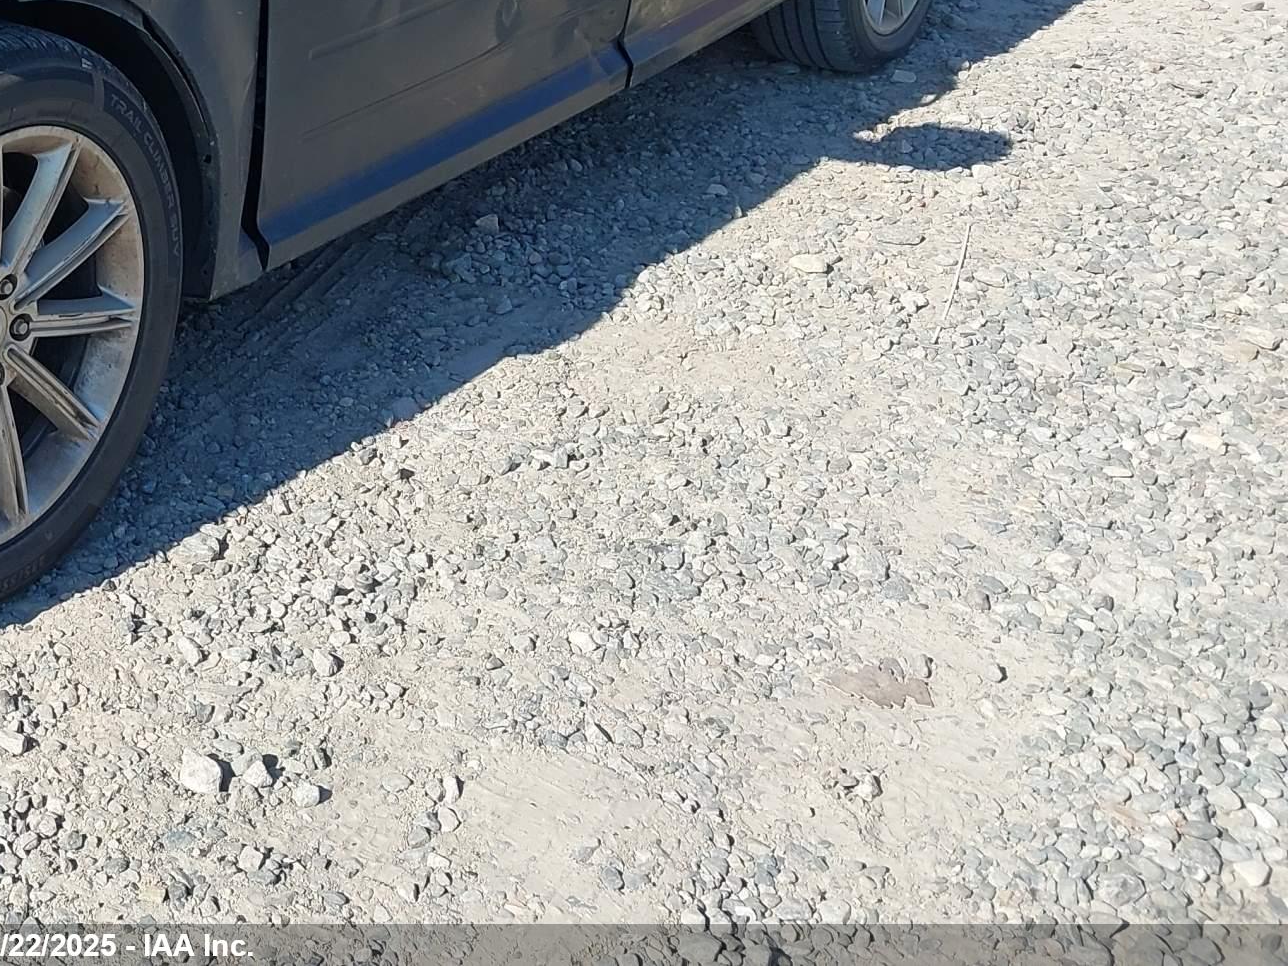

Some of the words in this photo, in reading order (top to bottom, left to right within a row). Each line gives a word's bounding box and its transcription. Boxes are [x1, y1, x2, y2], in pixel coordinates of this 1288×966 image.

[110, 93, 146, 133] TRAIL
[143, 131, 175, 209] CLIMBER
[169, 216, 181, 257] SUV
